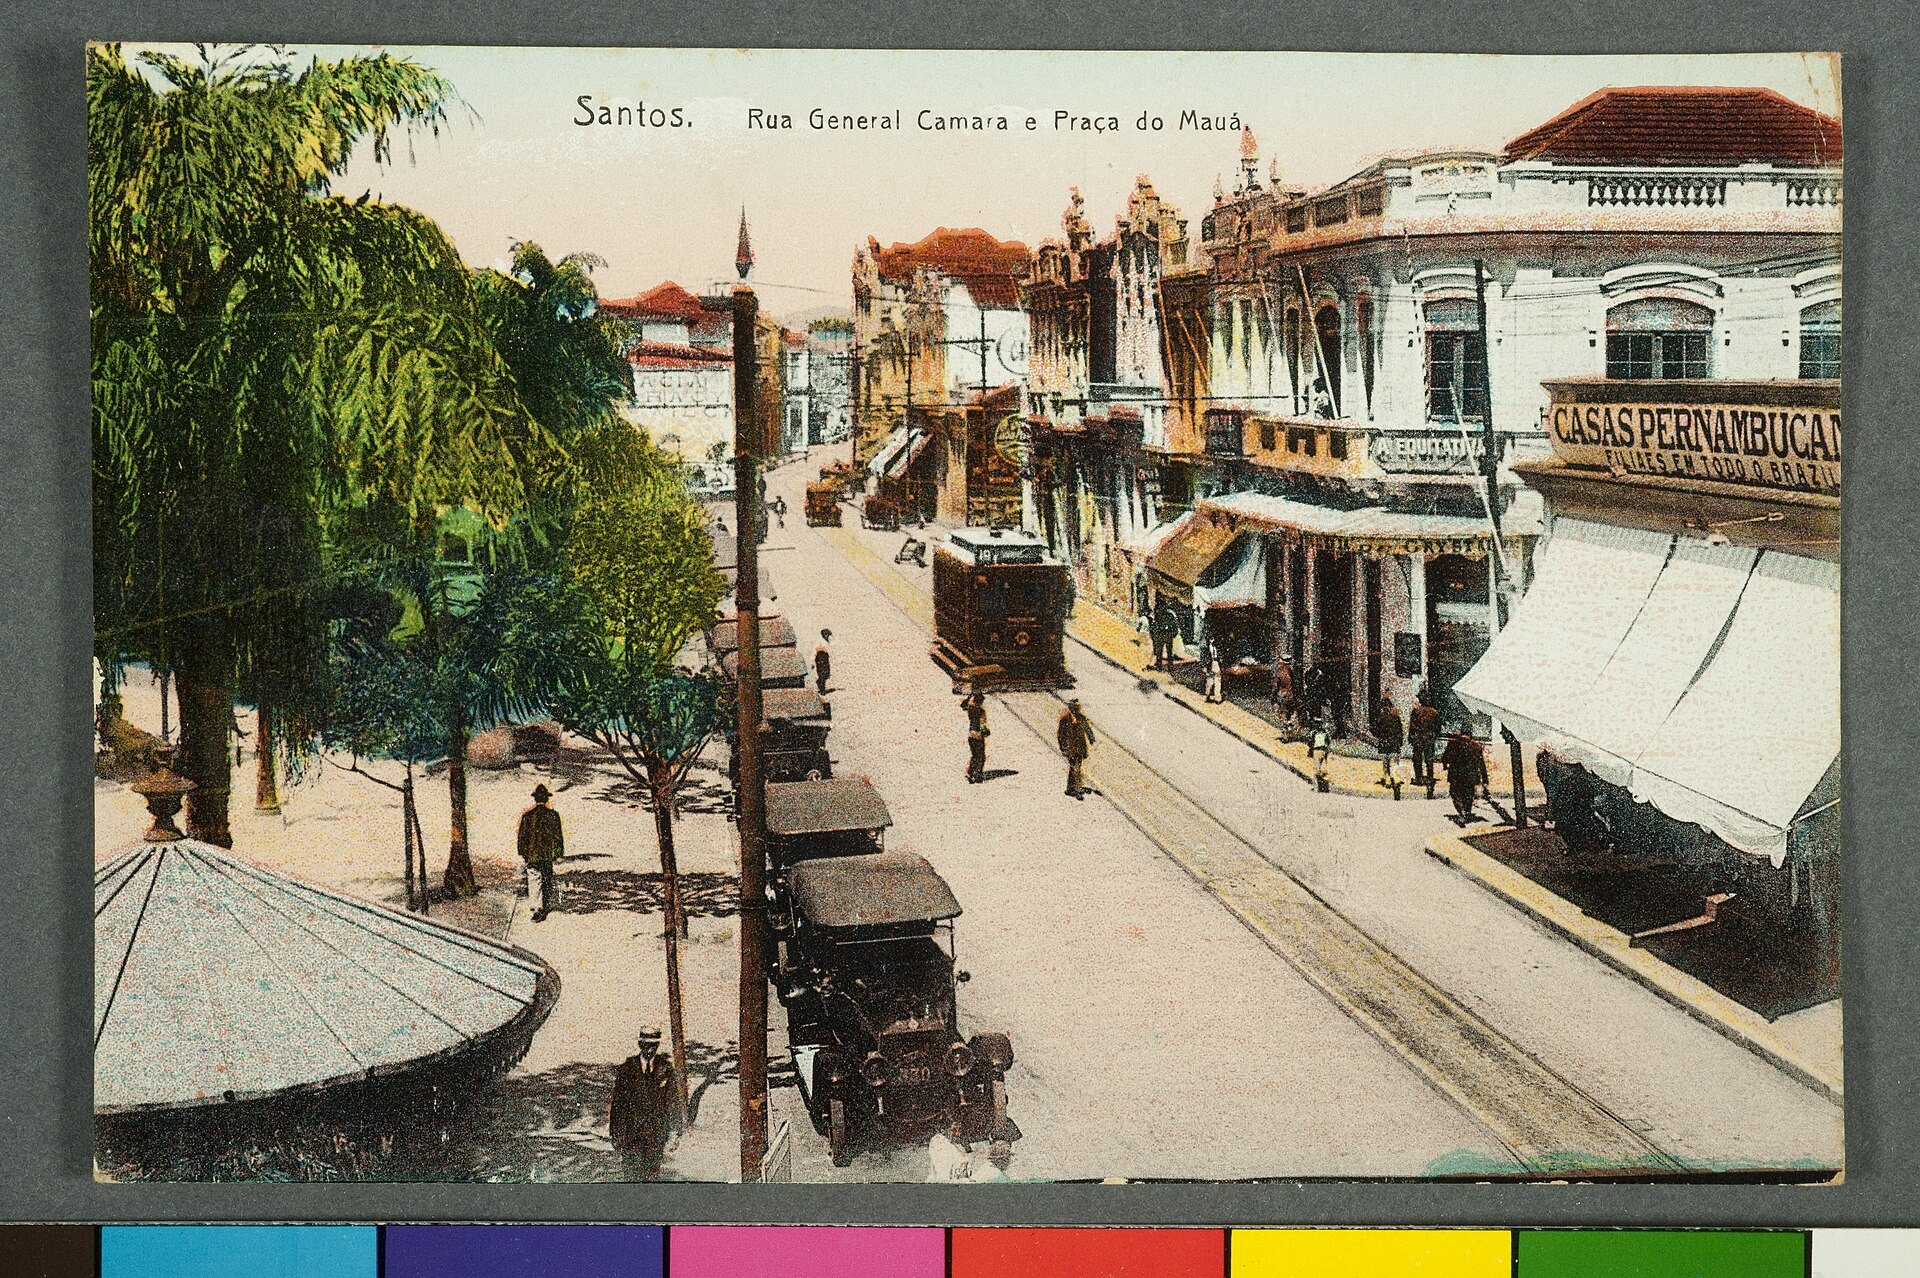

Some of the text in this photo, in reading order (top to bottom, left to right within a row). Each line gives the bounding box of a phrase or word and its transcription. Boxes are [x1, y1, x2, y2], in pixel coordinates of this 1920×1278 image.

[1554, 406, 1634, 446] CASAS
[1672, 453, 1695, 472] EM
[1701, 455, 1746, 478] TODO
[1753, 460, 1763, 480] O
[1769, 461, 1840, 487] BRAZIL
